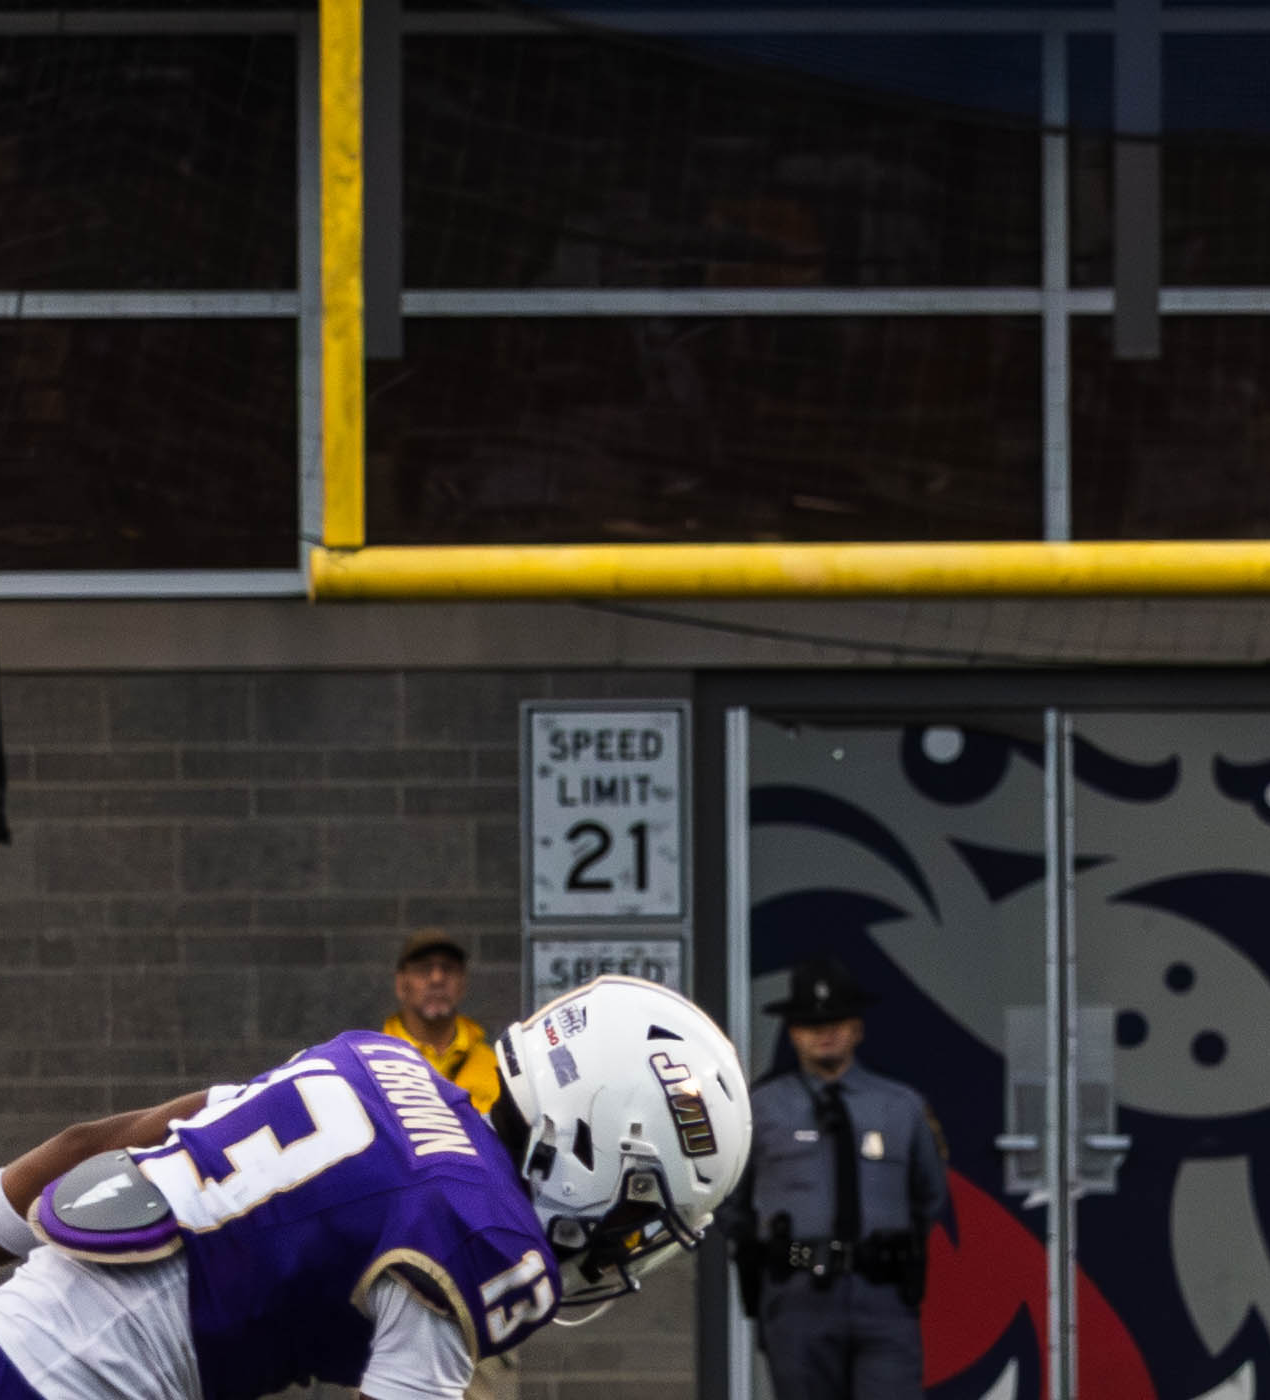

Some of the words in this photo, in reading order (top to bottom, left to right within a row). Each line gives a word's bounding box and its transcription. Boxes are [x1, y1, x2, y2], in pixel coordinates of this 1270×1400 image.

[549, 727, 665, 763] SPEED
[557, 775, 650, 807] LIMIT
[565, 820, 648, 892] 21
[367, 1058, 479, 1157] BROWN
[479, 1248, 557, 1346] 13
